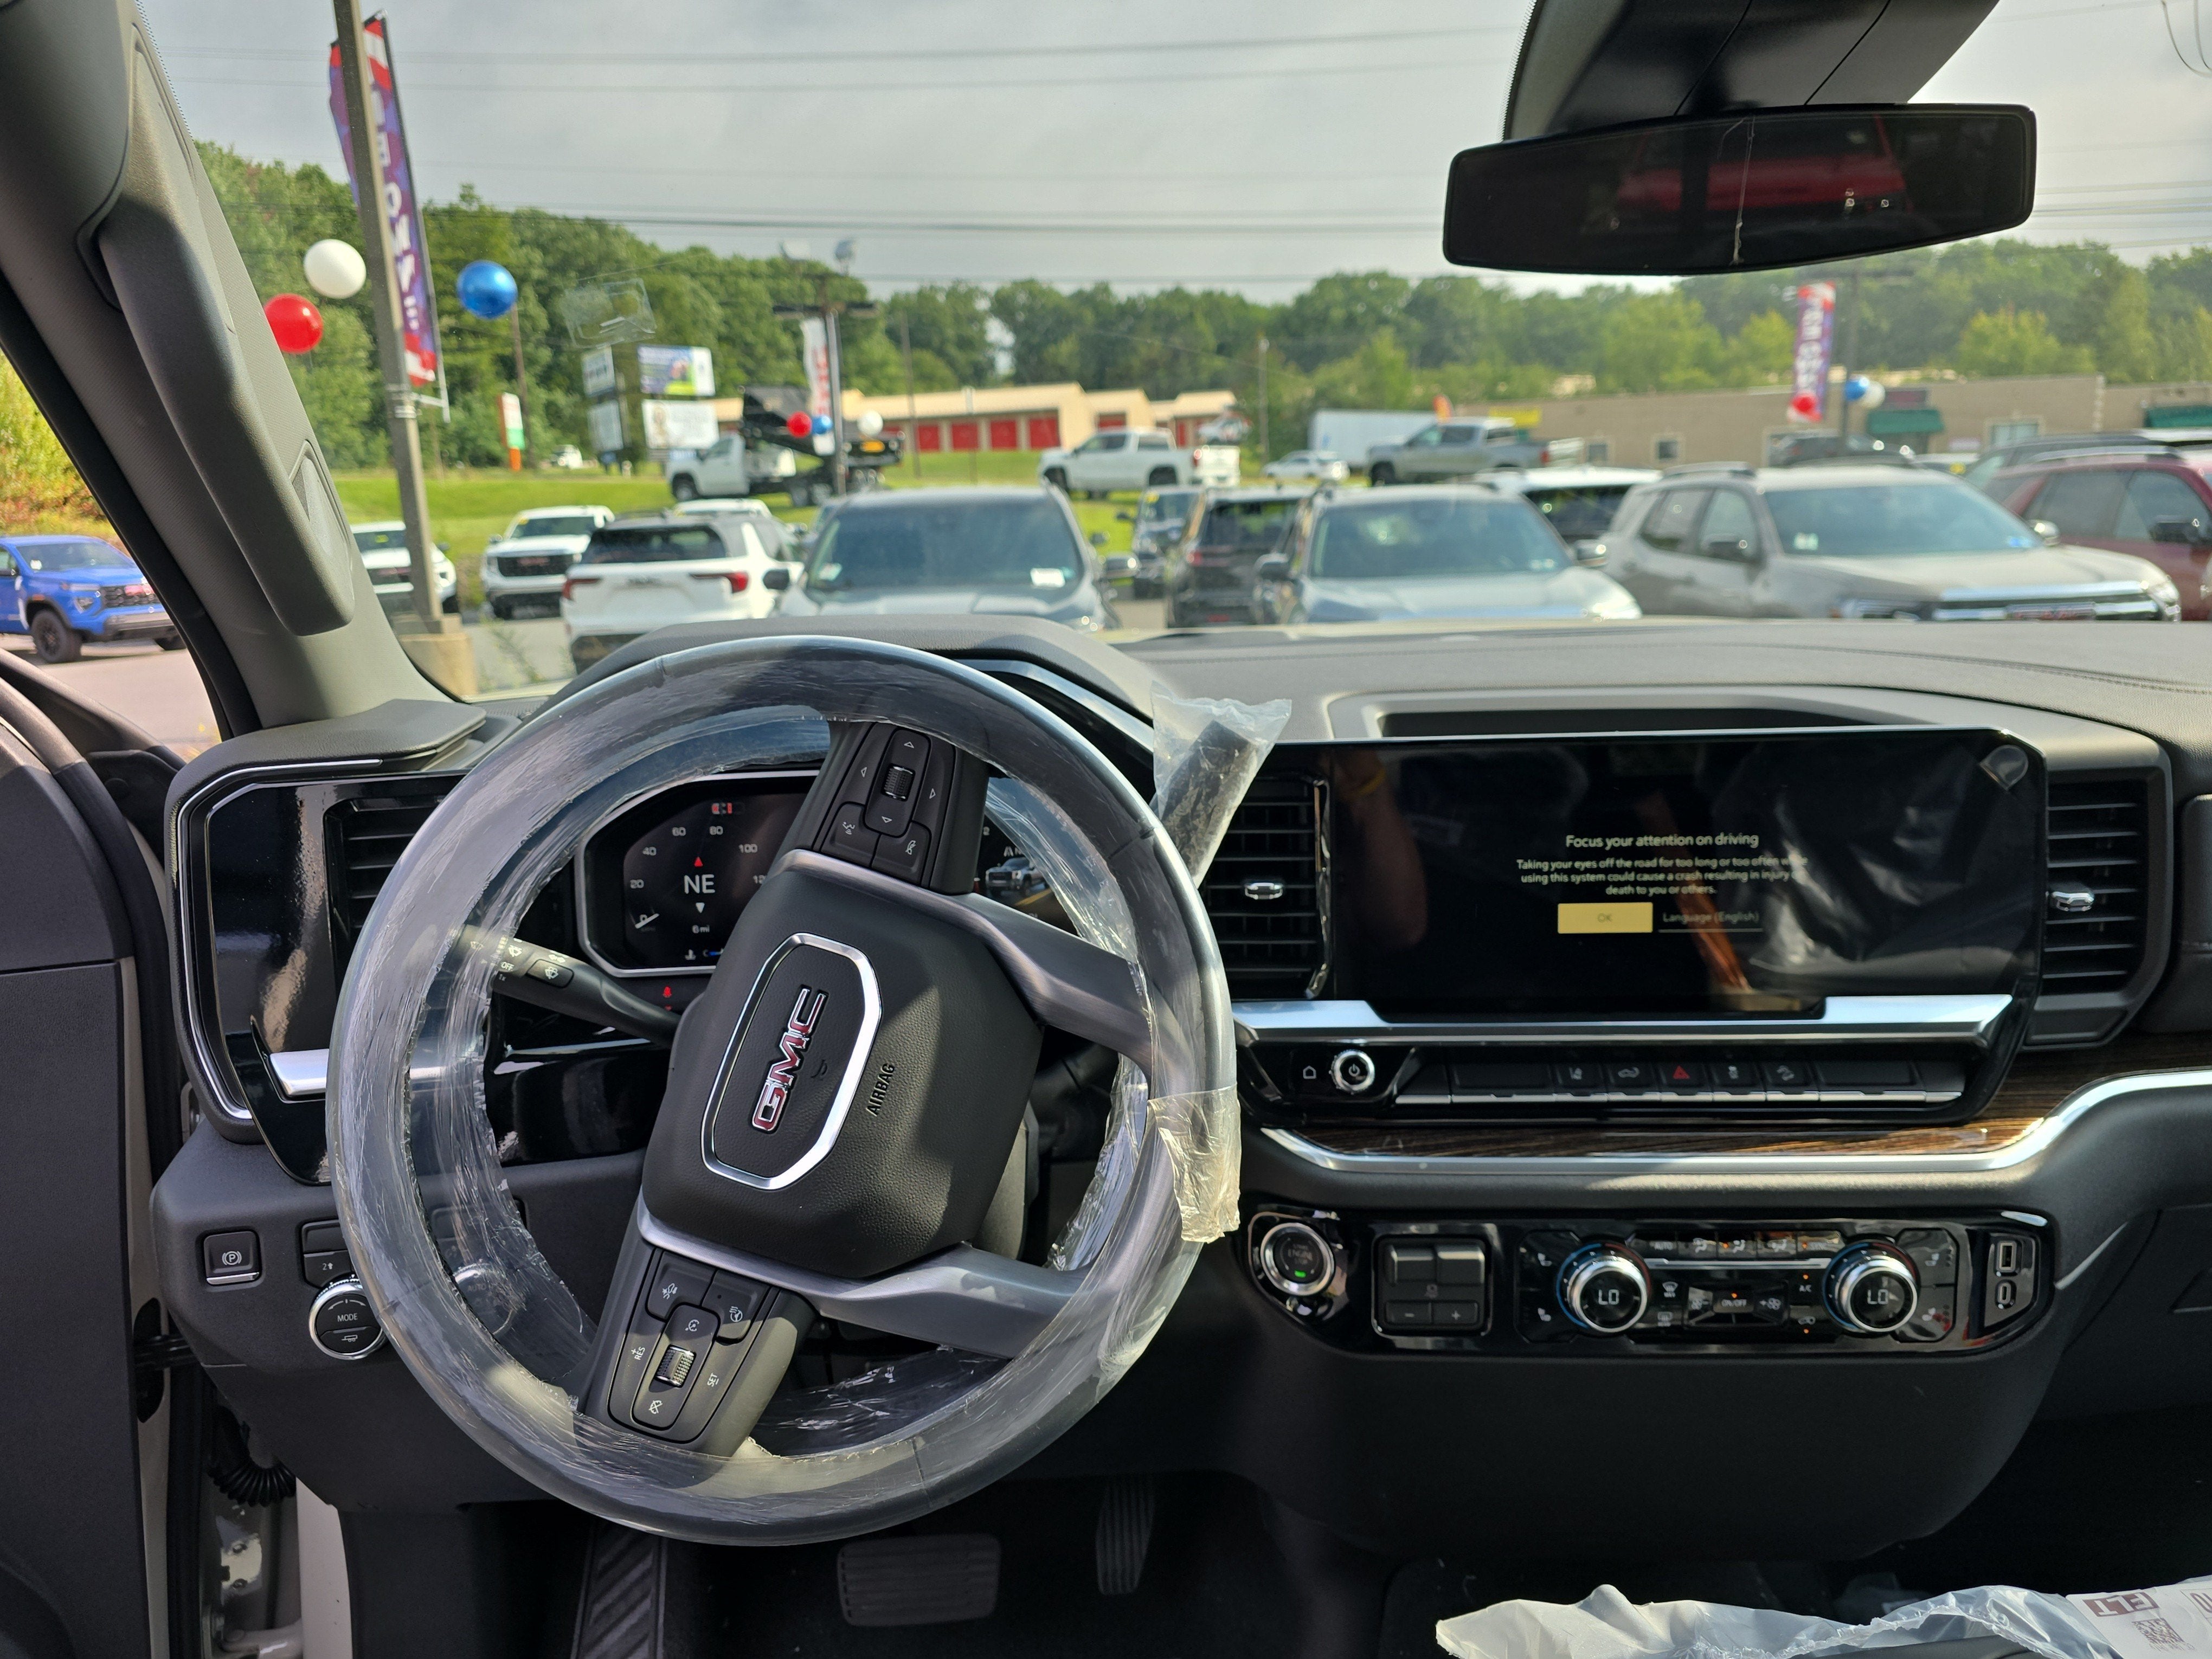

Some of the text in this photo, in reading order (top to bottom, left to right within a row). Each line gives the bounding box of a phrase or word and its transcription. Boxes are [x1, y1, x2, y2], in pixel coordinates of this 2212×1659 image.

[1565, 832, 1759, 850] Focus your attention on driving
[642, 846, 657, 856] 40
[738, 844, 758, 853] 100
[1516, 859, 1549, 871] Taking
[1550, 860, 1572, 871] your
[1574, 860, 1597, 871] eyes
[1599, 857, 1615, 868] off
[1616, 857, 1633, 868] the
[1634, 857, 1658, 867] road
[1659, 856, 1674, 867] for
[1675, 858, 1694, 867] too
[1694, 856, 1718, 870] long
[1719, 858, 1731, 866] or
[1732, 857, 1750, 866] too
[1751, 855, 1779, 866] often
[684, 874, 715, 894] NE
[753, 874, 766, 884] 12
[1521, 872, 1549, 885] using
[1550, 872, 1569, 883] this
[1570, 872, 1606, 885] system
[1607, 871, 1635, 882] could
[1636, 872, 1666, 882] cause
[1667, 872, 1674, 881] a
[1675, 869, 1703, 881] crash
[1704, 870, 1748, 883] resulting
[1750, 869, 1760, 879] in
[1761, 870, 1789, 882] injury
[1605, 884, 1635, 895] death
[1636, 886, 1647, 895] to
[1648, 886, 1667, 897] you
[1668, 886, 1680, 895] or
[1597, 912, 1613, 923] OK
[1662, 911, 1760, 925] Language (English)
[500, 961, 515, 971] OFF
[751, 987, 827, 1133] GMC
[866, 1063, 896, 1116] AIRBAG
[1598, 1289, 1619, 1305] LO
[1867, 1289, 1889, 1305] LO
[337, 1313, 358, 1322] MODE
[634, 1346, 645, 1360] RES
[707, 1372, 718, 1387] SET
